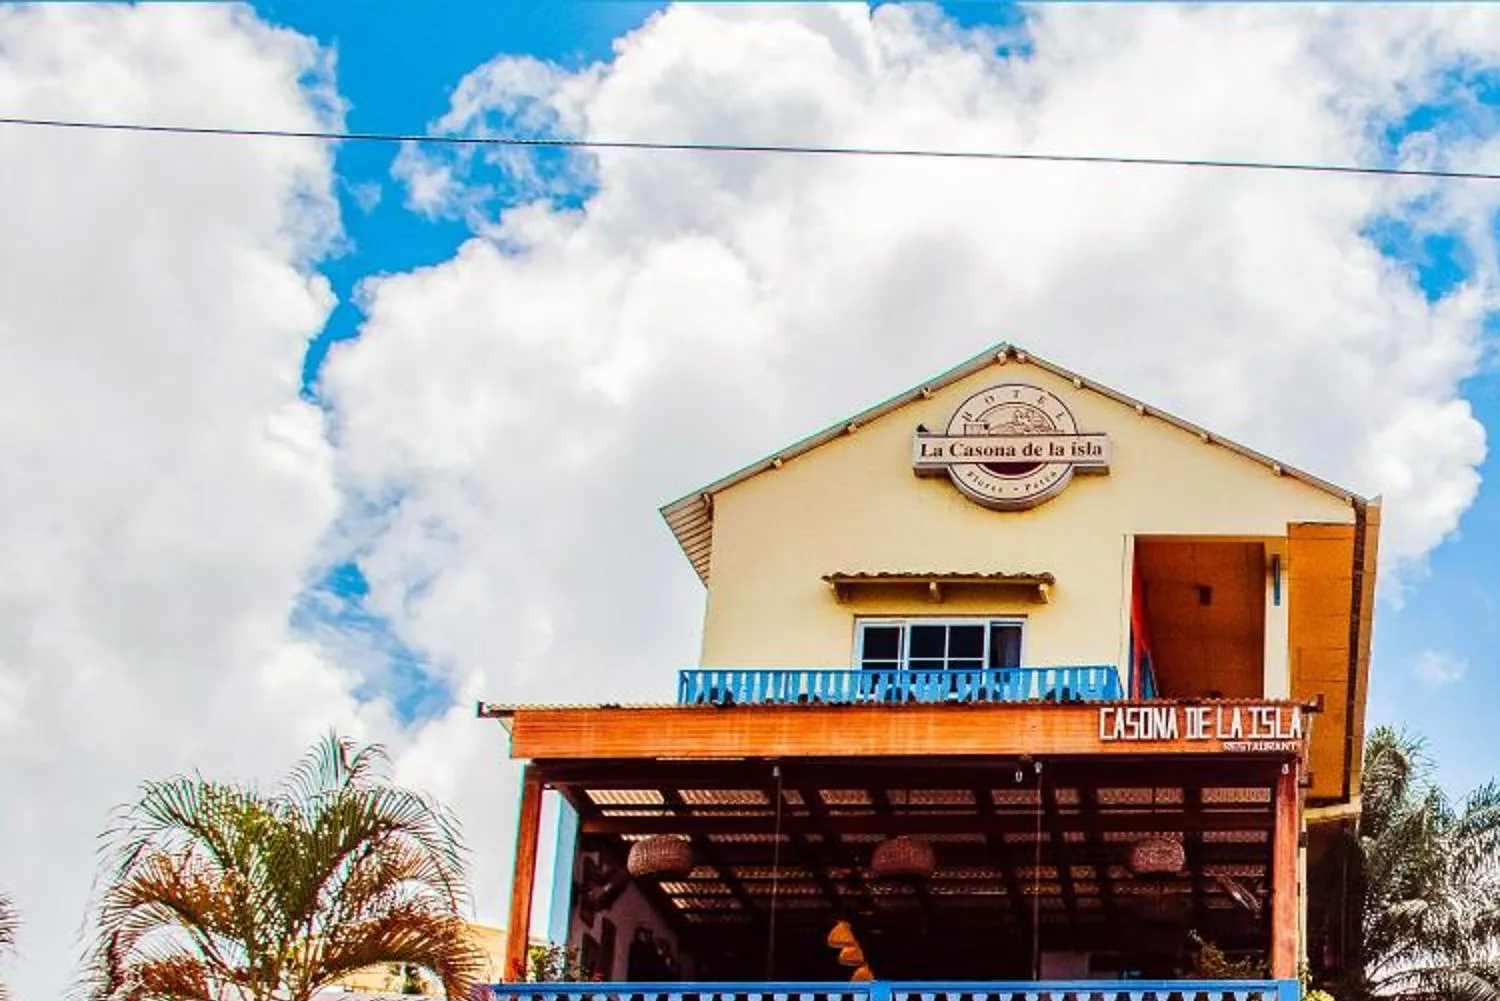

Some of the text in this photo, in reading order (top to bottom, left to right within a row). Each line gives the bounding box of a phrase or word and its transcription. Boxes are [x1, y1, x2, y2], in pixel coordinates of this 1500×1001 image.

[961, 389, 1066, 422] HOTEL
[920, 441, 1103, 458] La Casona de la isla
[1100, 707, 1302, 740] CASONA DE LA ISLA
